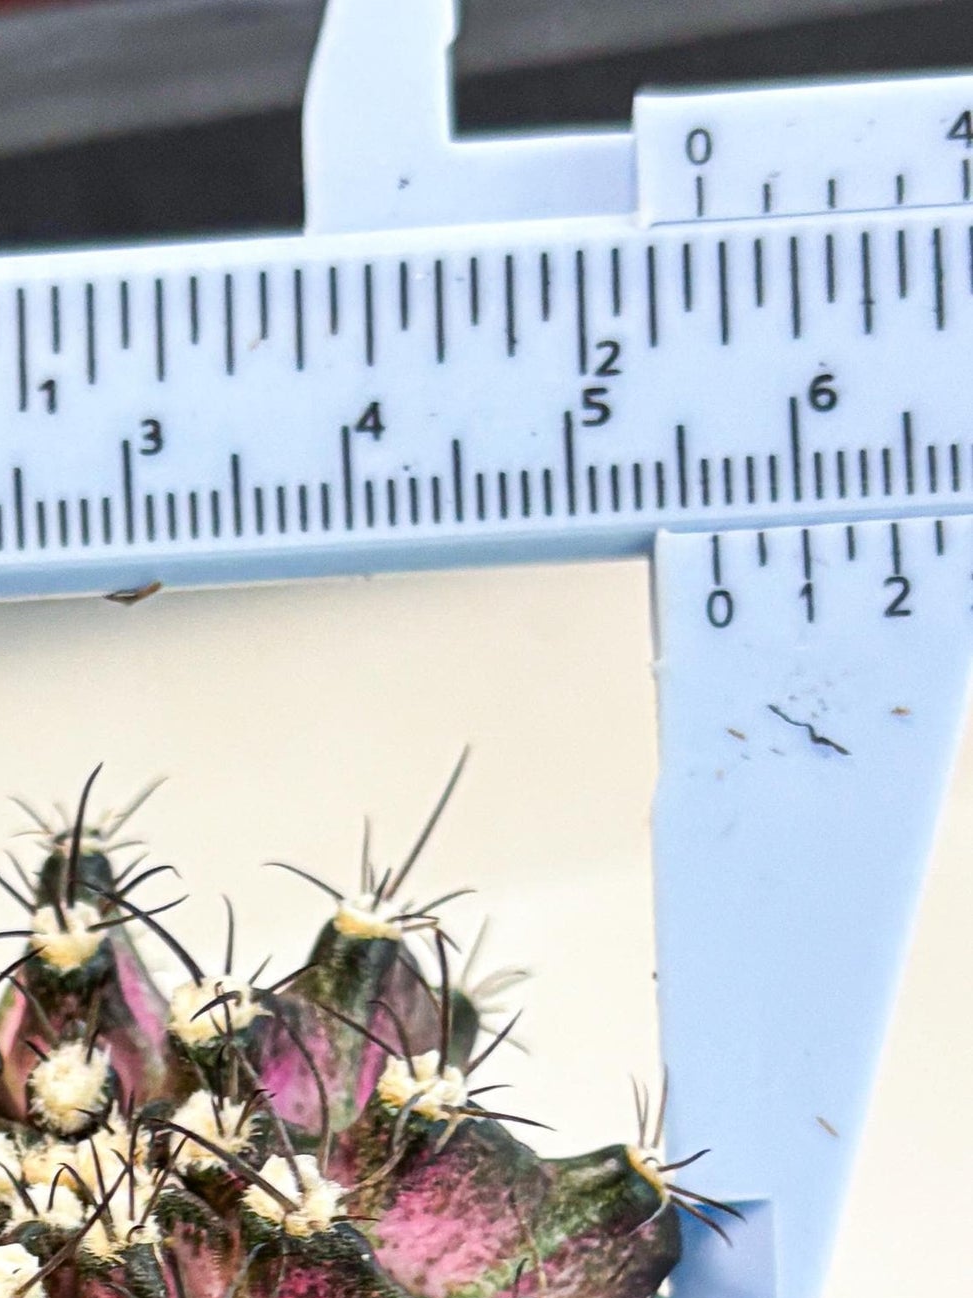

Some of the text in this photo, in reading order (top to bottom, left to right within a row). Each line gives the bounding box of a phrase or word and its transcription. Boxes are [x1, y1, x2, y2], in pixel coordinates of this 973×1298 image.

[685, 110, 973, 166] 0 4
[37, 379, 56, 415] 1
[595, 340, 622, 376] 2
[139, 419, 163, 456] 3
[355, 401, 386, 441] 4
[582, 387, 611, 427] 5
[808, 374, 838, 412] 6
[707, 575, 912, 629] 0 1 2
